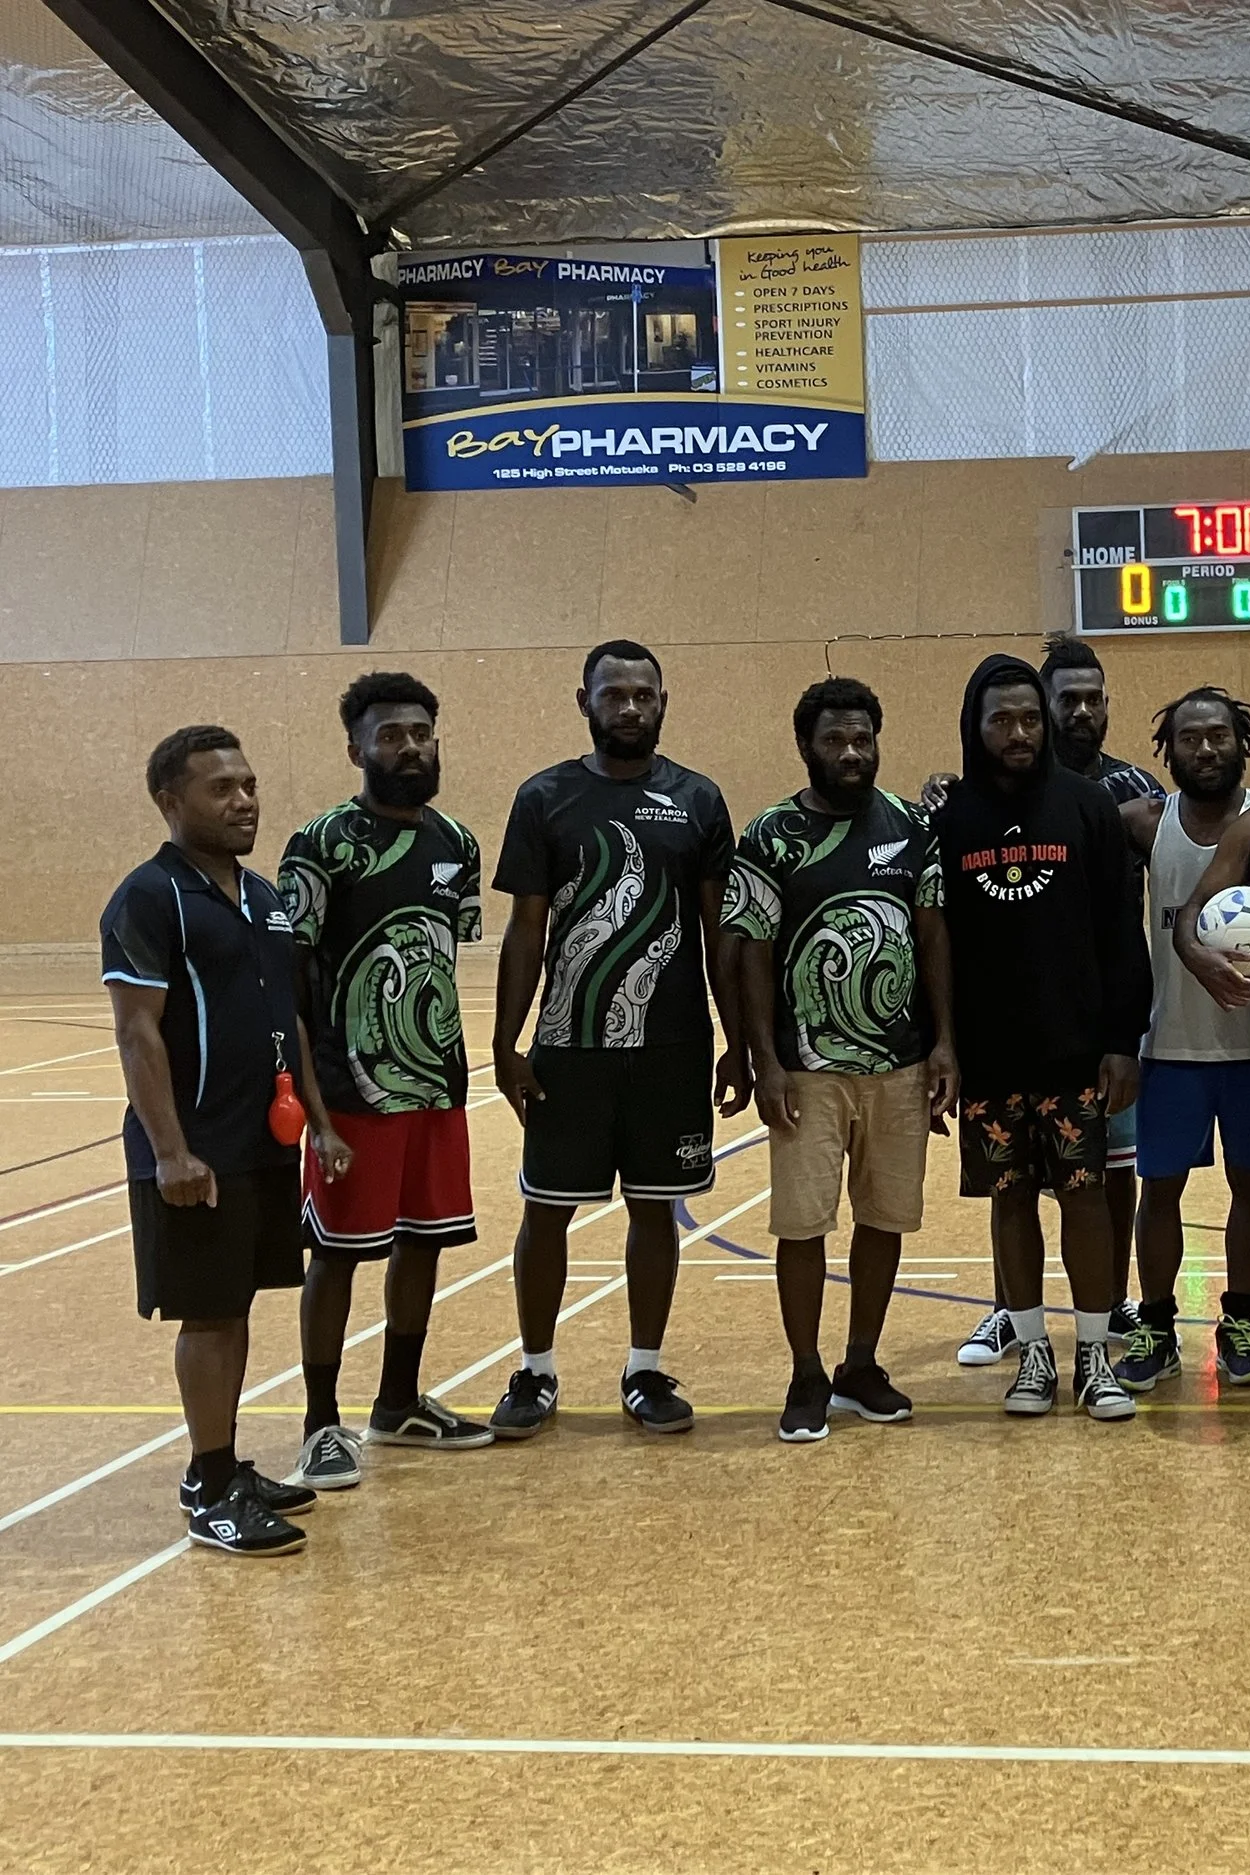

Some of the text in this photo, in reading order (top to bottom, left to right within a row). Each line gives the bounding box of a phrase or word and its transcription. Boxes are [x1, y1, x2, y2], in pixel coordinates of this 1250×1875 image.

[747, 246, 834, 267] Keeping you
[399, 258, 666, 286] PHARMACY Bay PHARMACY
[739, 254, 852, 282] in Good health
[753, 286, 836, 298] OPEN 7 DAYS
[753, 301, 849, 313] PRESCRIPTIONS
[754, 318, 842, 330] SPORT INJURY
[755, 330, 833, 341] PREVENTION
[755, 346, 835, 358] HEALTHCARE
[756, 362, 817, 373] VITAMINS
[756, 378, 828, 389] COSMETICS
[446, 423, 829, 459] Bay PHARMACY
[493, 460, 787, 480] 125 High Street Motueka Ph: 03 528 4196
[1082, 546, 1136, 565] HOME
[1182, 564, 1236, 579] PERIOD
[1121, 563, 1152, 614] 0
[1164, 584, 1188, 622] 0
[1123, 615, 1159, 626] BONUS
[634, 807, 688, 818] AOTEAROA
[976, 869, 1054, 901] BASKETBALL
